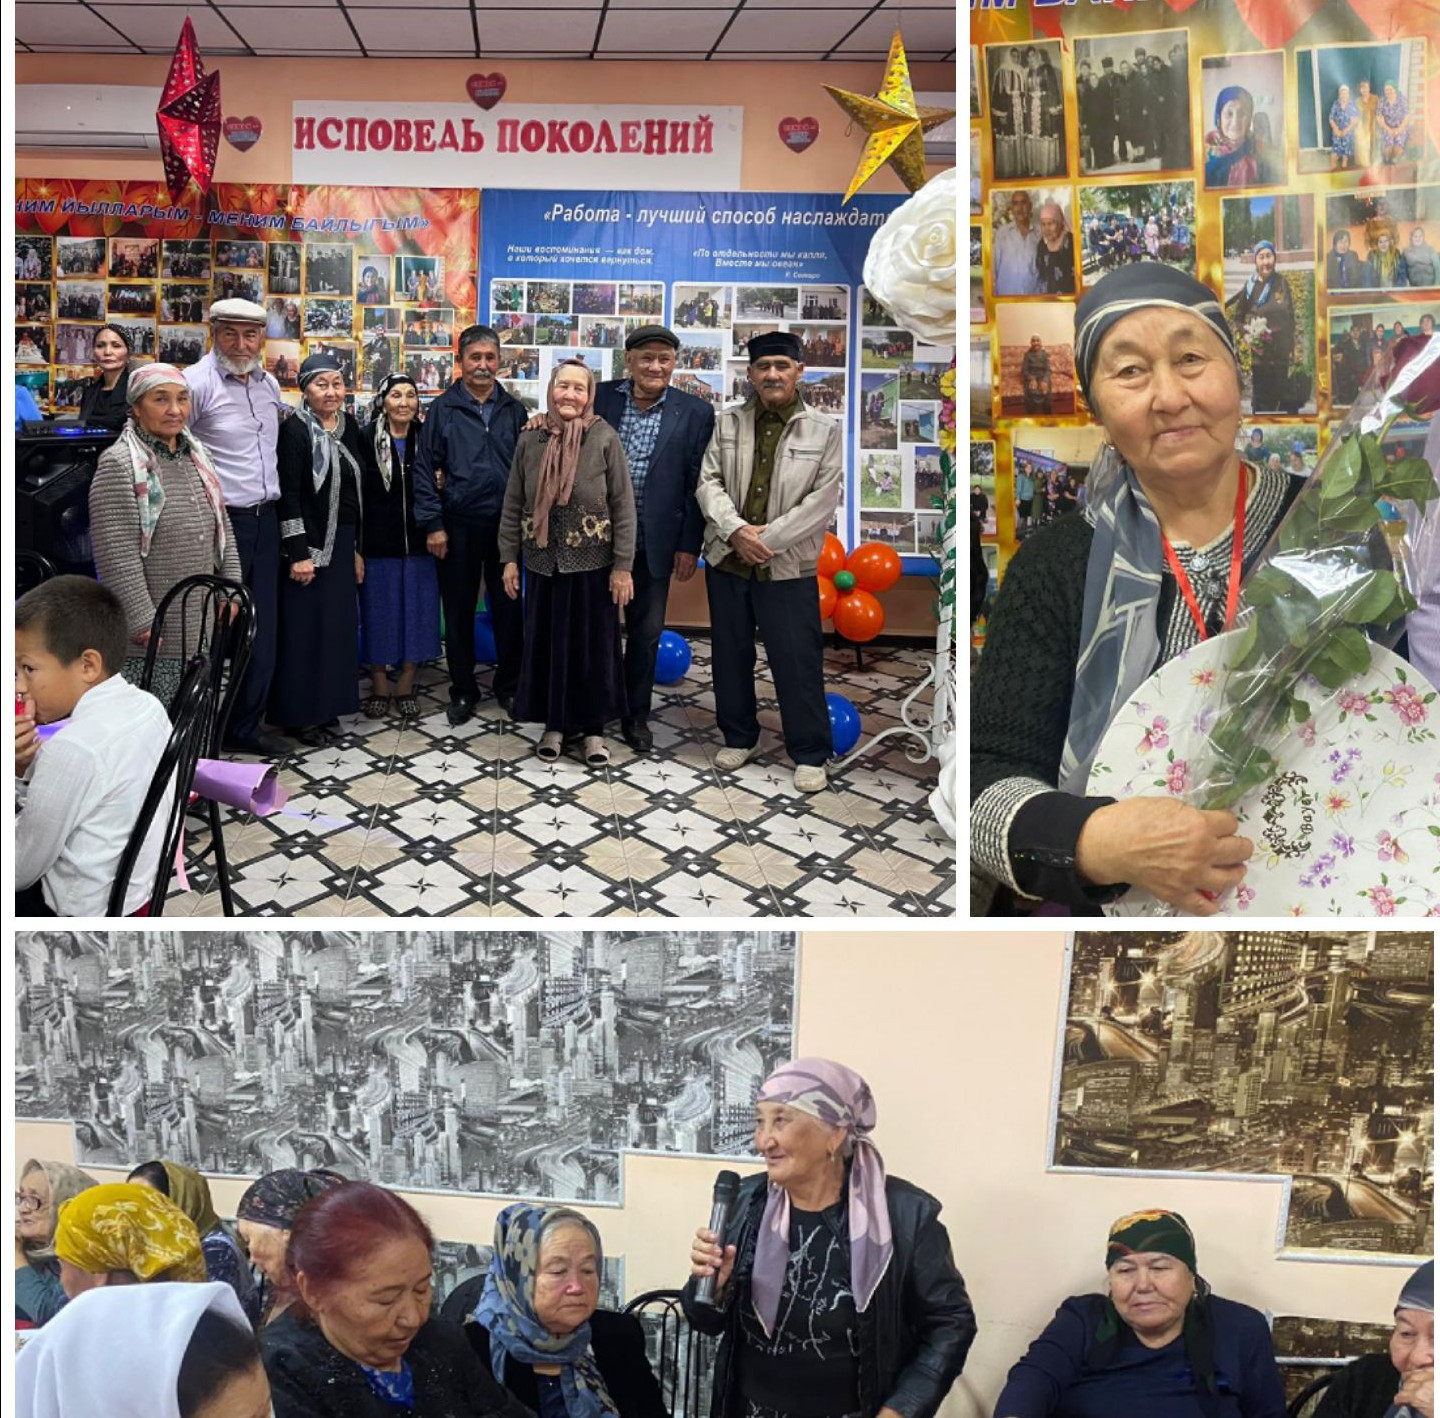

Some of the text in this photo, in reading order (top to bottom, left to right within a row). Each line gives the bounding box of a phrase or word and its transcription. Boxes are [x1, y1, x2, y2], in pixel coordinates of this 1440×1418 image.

[293, 116, 485, 153] ИСПОВЕДЬ
[496, 113, 715, 155] ПОКОЛЕНИЙ
[207, 210, 286, 230] МЕНИМ
[544, 203, 620, 223] «Работа
[636, 205, 706, 227] лучший
[712, 206, 777, 225] способ
[507, 244, 532, 254] Наши
